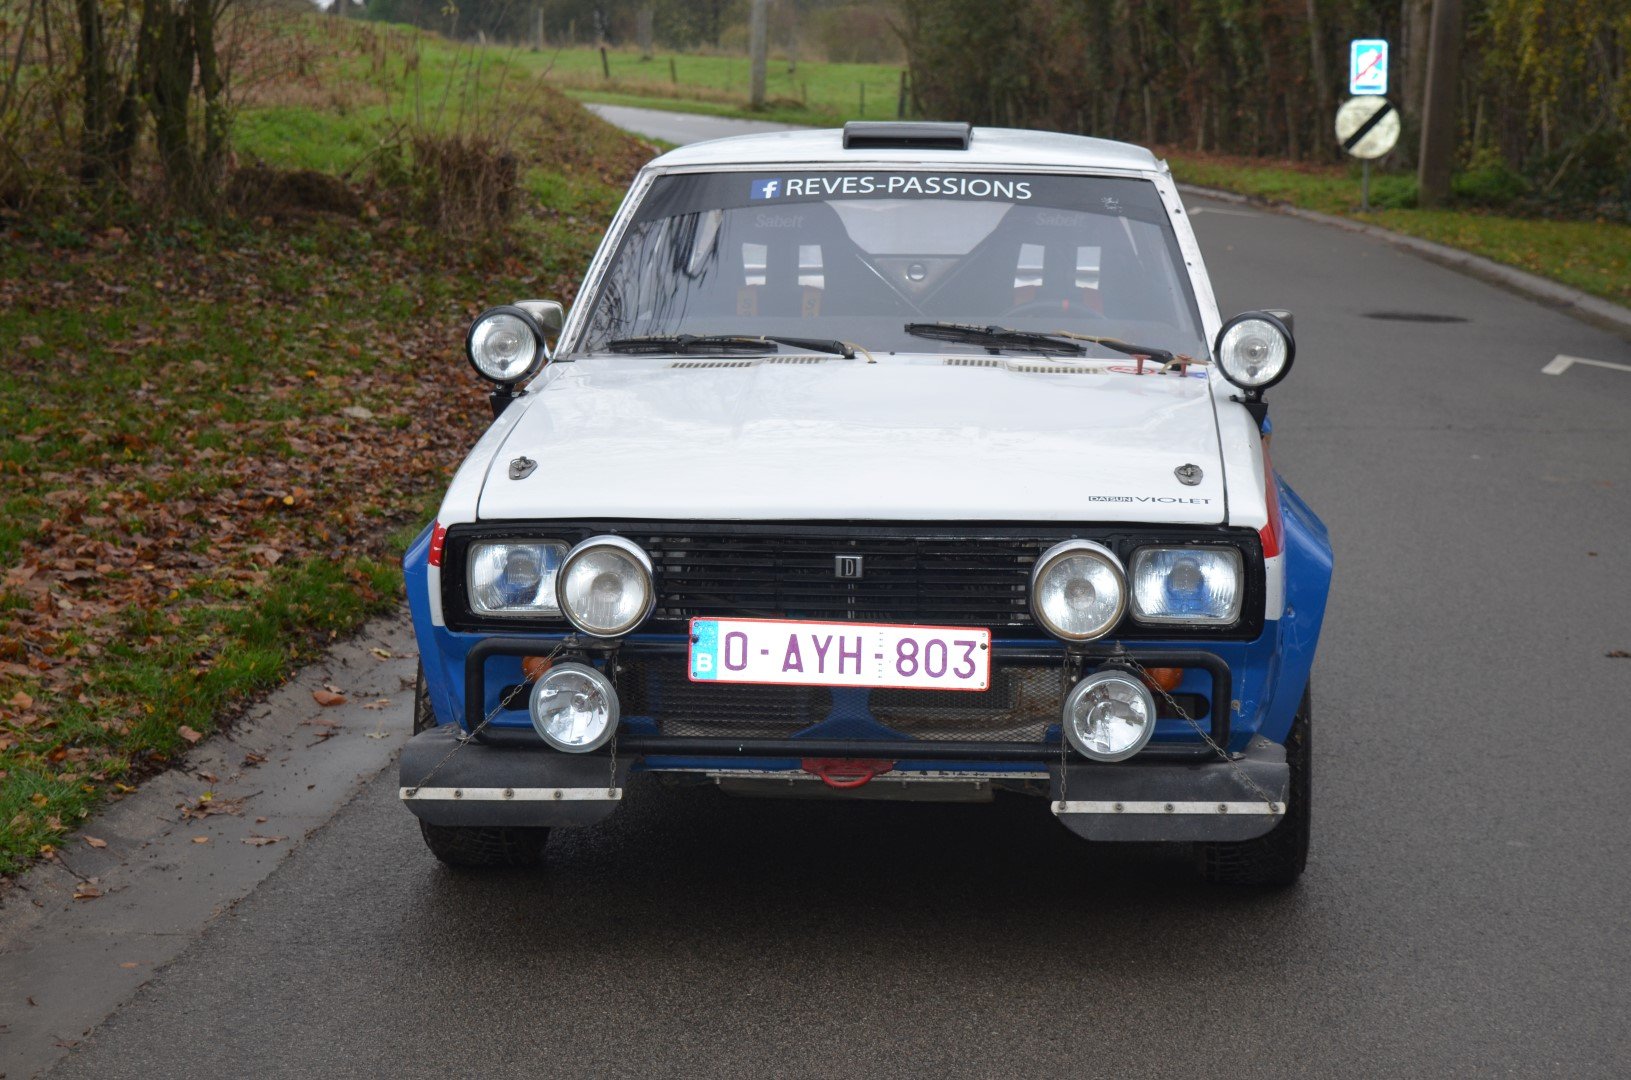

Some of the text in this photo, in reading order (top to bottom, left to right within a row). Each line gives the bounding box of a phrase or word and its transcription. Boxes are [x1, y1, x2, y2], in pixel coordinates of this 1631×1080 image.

[785, 176, 1033, 200] REVES-PASSIONS
[755, 213, 805, 229] Sabelt
[1135, 496, 1212, 505] VIOLET
[696, 653, 713, 673] B
